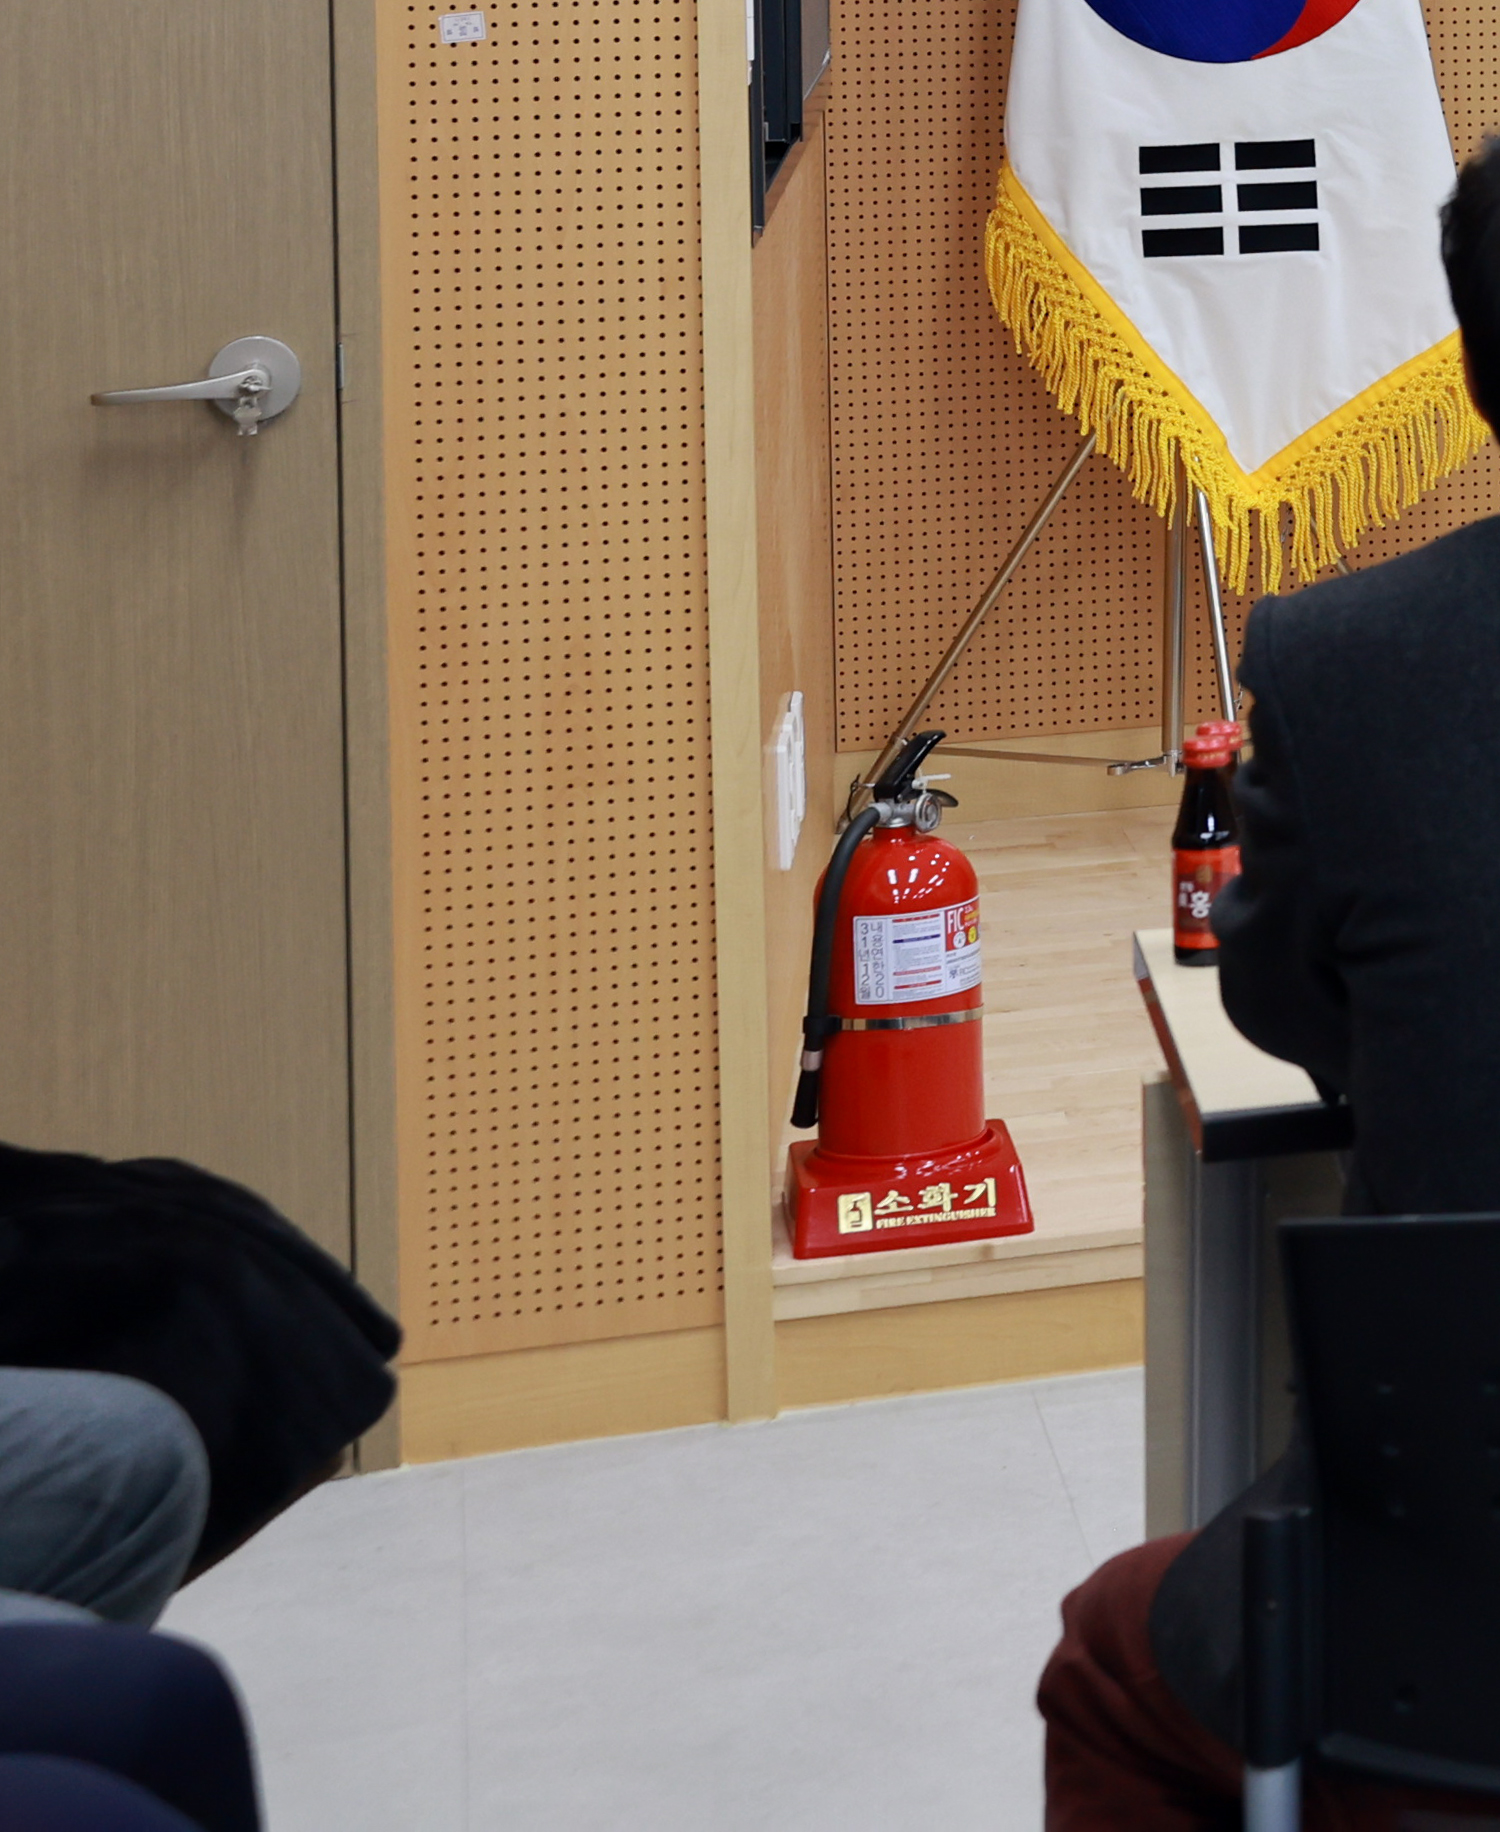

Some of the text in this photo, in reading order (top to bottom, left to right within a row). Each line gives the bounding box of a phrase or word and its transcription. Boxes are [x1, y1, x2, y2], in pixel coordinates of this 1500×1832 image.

[947, 908, 964, 934] FIC
[874, 1177, 997, 1215] 소화기
[876, 1215, 906, 1230] FIRE
